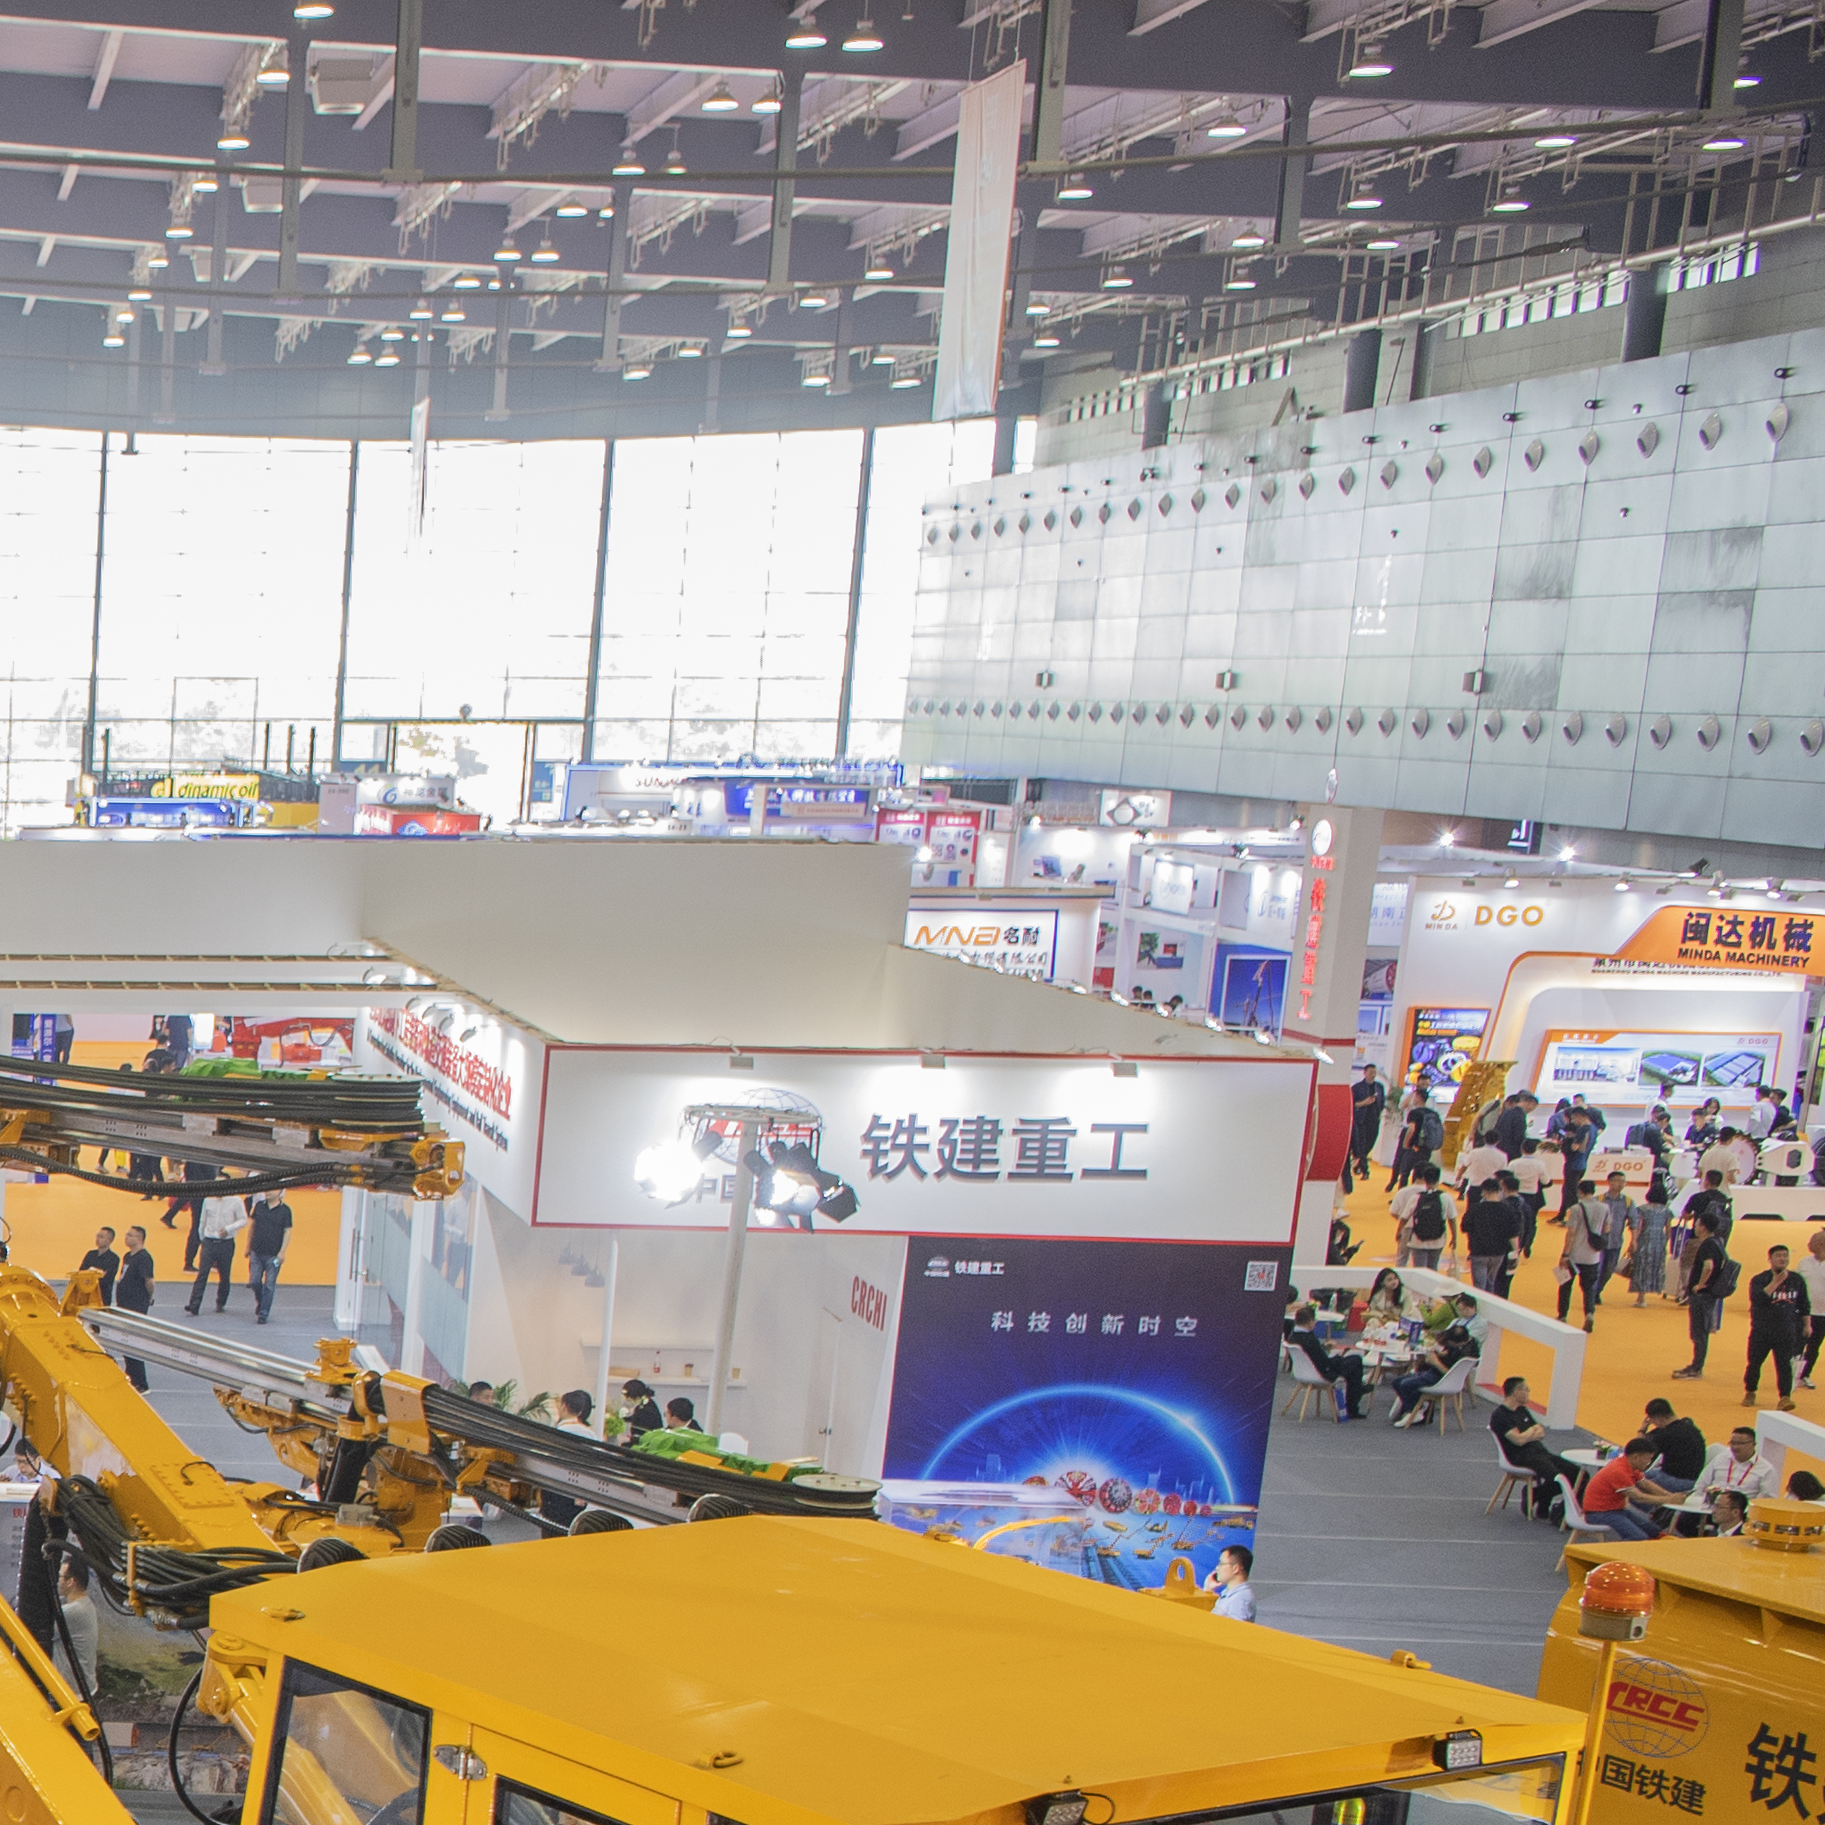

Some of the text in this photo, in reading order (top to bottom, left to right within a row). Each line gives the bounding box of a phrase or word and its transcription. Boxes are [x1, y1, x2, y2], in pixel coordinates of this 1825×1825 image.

[238, 779, 259, 800] oil
[1474, 905, 1544, 928] DGO
[1680, 911, 1816, 953] 闽达机械
[1677, 947, 1721, 962] MINDA
[1725, 950, 1810, 968] MACHINERY
[860, 1111, 1150, 1183] 铁建重工
[1613, 1162, 1644, 1171] DGO
[954, 1260, 1005, 1275] 铁建重工
[851, 1274, 887, 1332] CRCHI
[990, 1308, 1200, 1338] 科技创新时空
